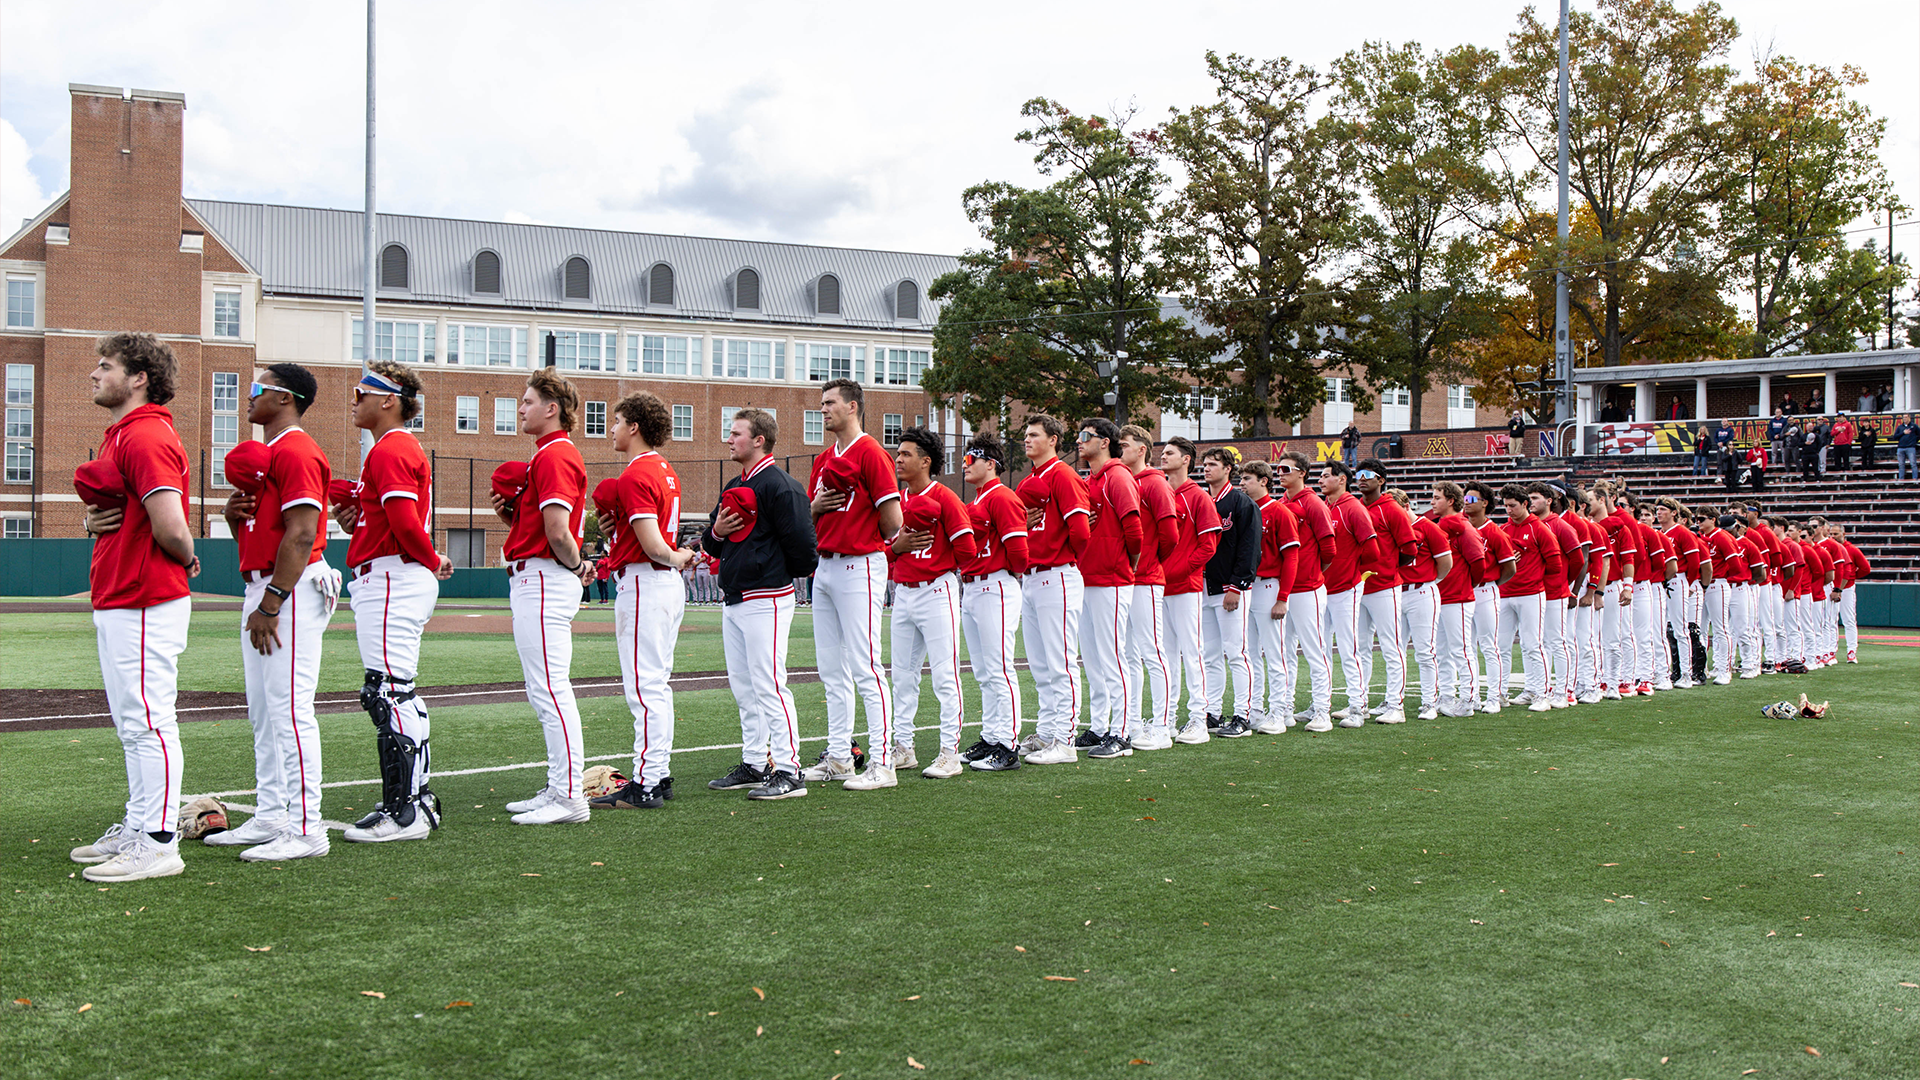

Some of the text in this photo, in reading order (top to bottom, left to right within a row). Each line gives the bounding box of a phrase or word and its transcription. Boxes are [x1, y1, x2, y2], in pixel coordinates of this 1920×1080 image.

[1269, 441, 1288, 462] M
[1317, 440, 1342, 461] M
[1423, 437, 1452, 457] M
[1485, 434, 1507, 456] N
[1539, 430, 1556, 457] N
